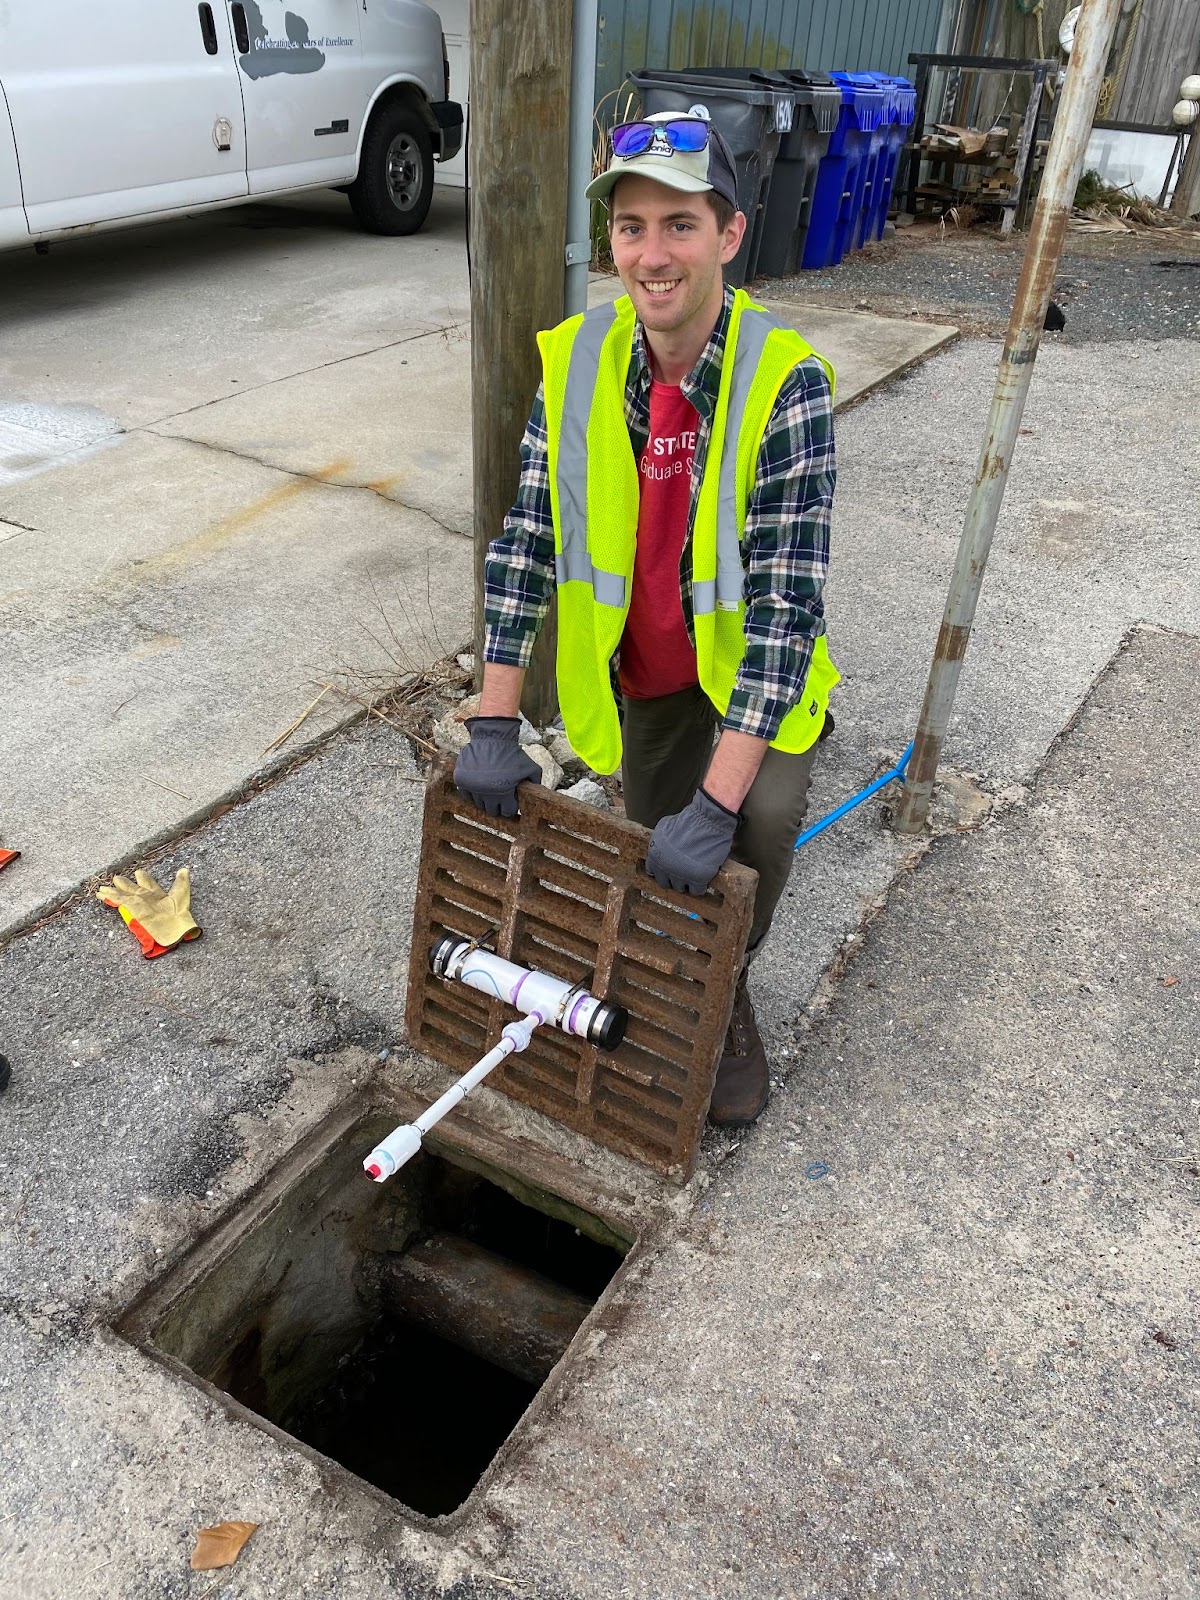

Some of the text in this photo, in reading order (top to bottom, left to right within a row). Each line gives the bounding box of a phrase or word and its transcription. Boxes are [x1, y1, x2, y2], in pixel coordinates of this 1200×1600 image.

[318, 36, 324, 47] of
[325, 36, 353, 47] Excellence
[653, 431, 696, 456] STATE
